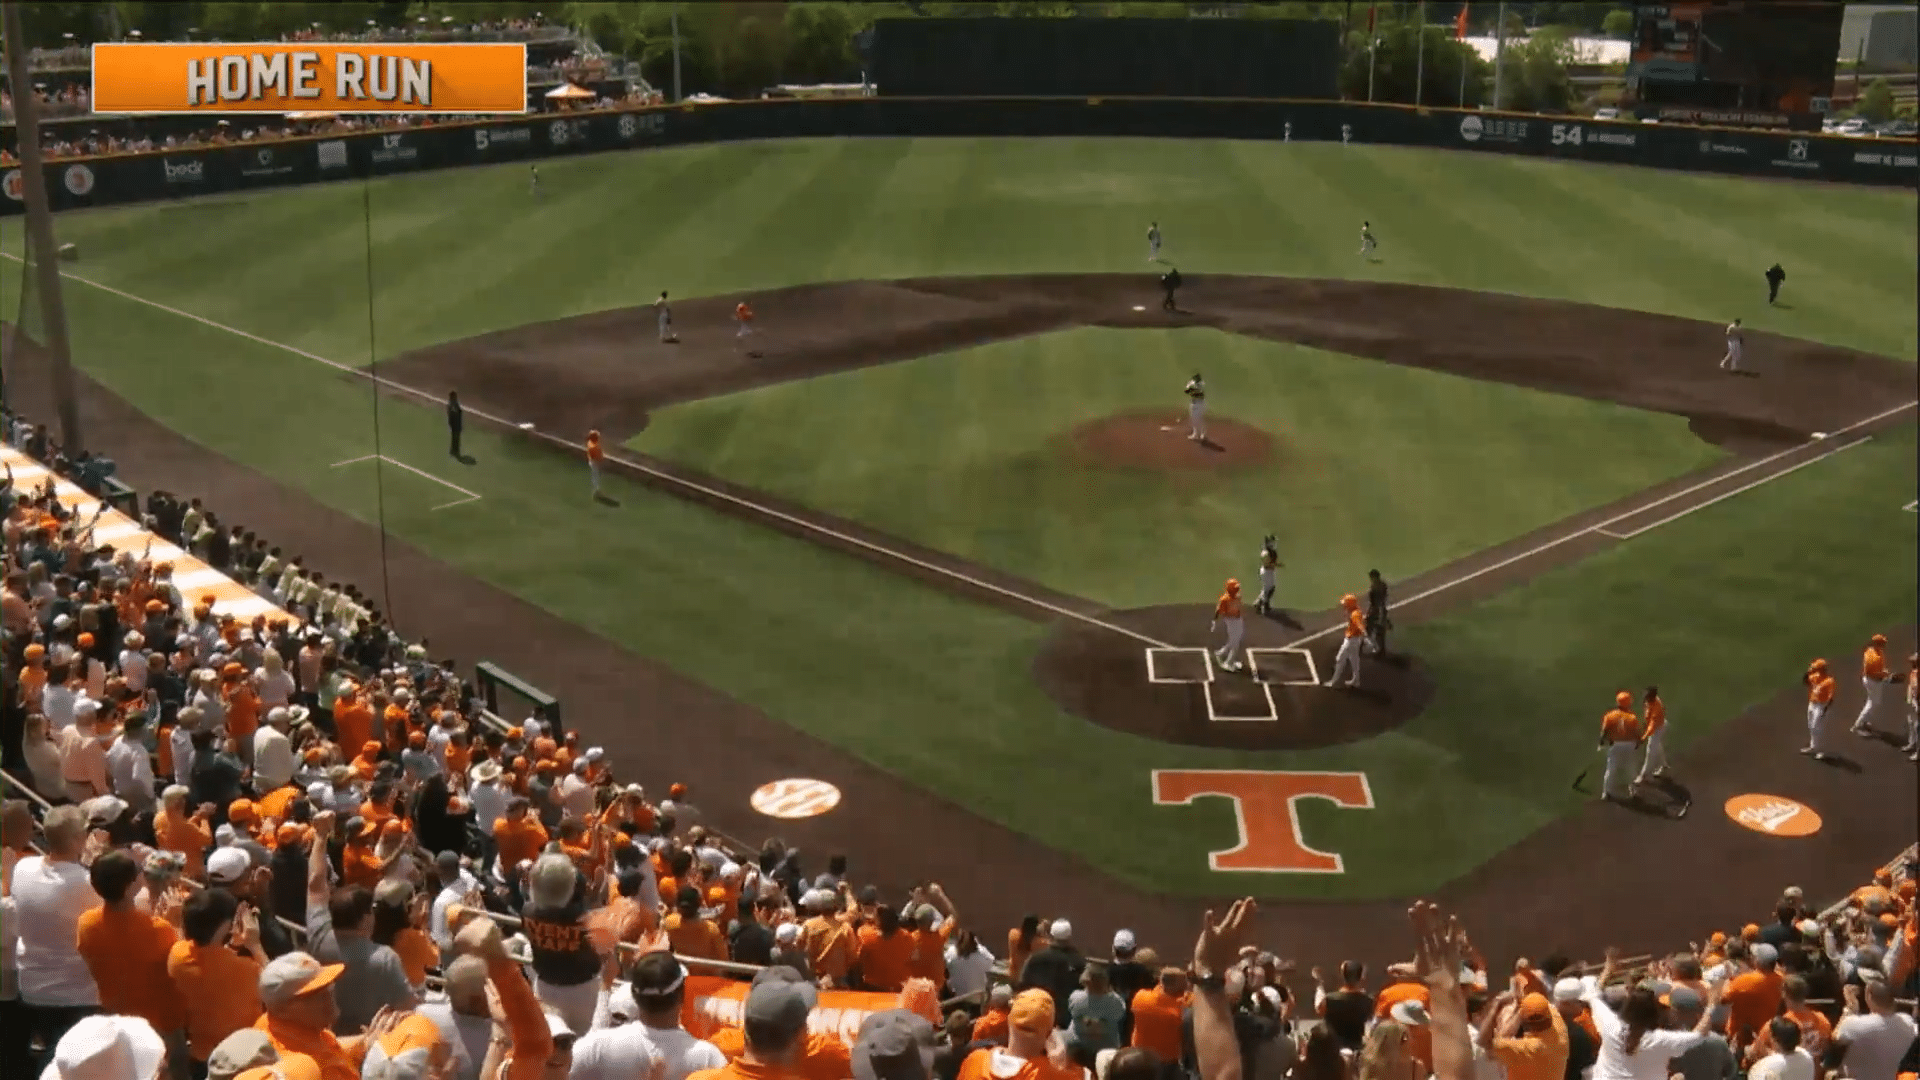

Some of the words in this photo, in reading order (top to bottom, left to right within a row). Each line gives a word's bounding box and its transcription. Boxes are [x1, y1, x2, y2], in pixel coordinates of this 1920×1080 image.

[475, 129, 489, 149] 5
[1551, 124, 1583, 146] 54
[1152, 769, 1376, 874] T
